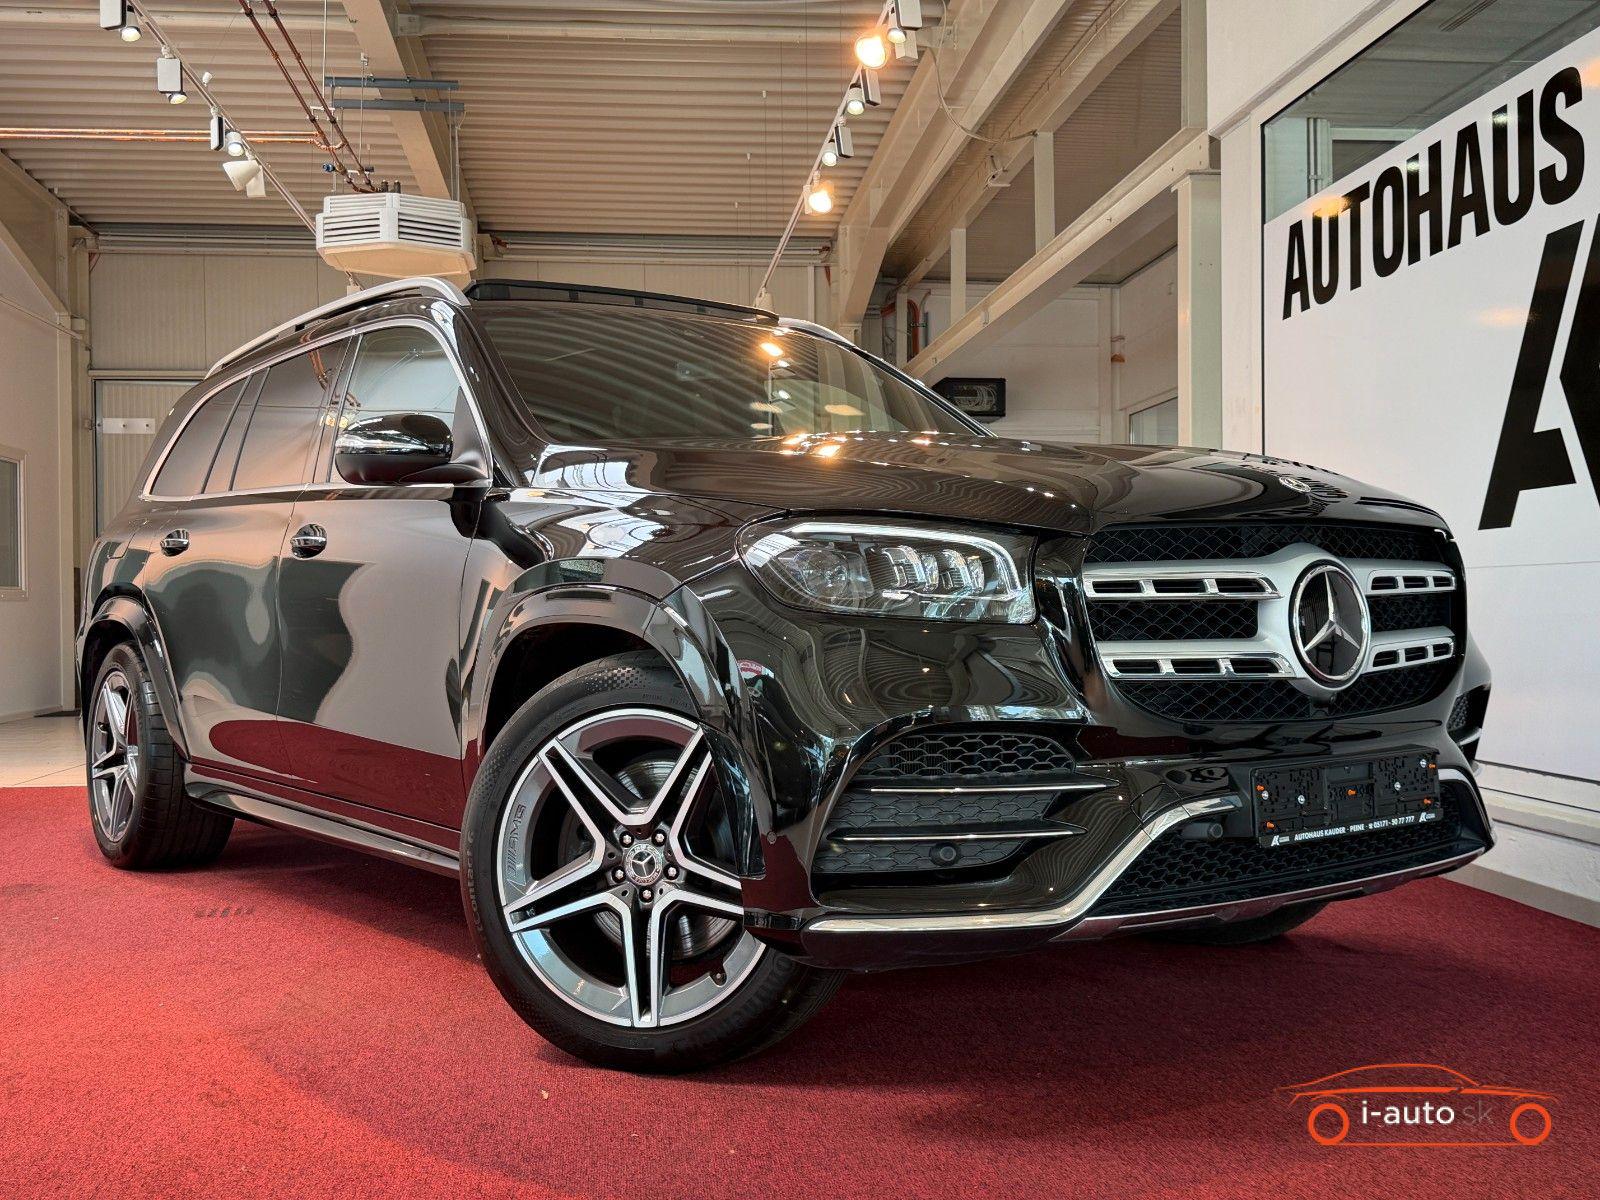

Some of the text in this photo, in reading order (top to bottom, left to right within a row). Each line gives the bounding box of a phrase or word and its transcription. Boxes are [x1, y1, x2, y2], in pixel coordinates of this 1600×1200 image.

[1283, 67, 1585, 321] AUTOHAUS
[1294, 829, 1325, 841] AUTOHAUS
[1324, 826, 1347, 837] KAUDER
[1349, 823, 1366, 833] PEINE
